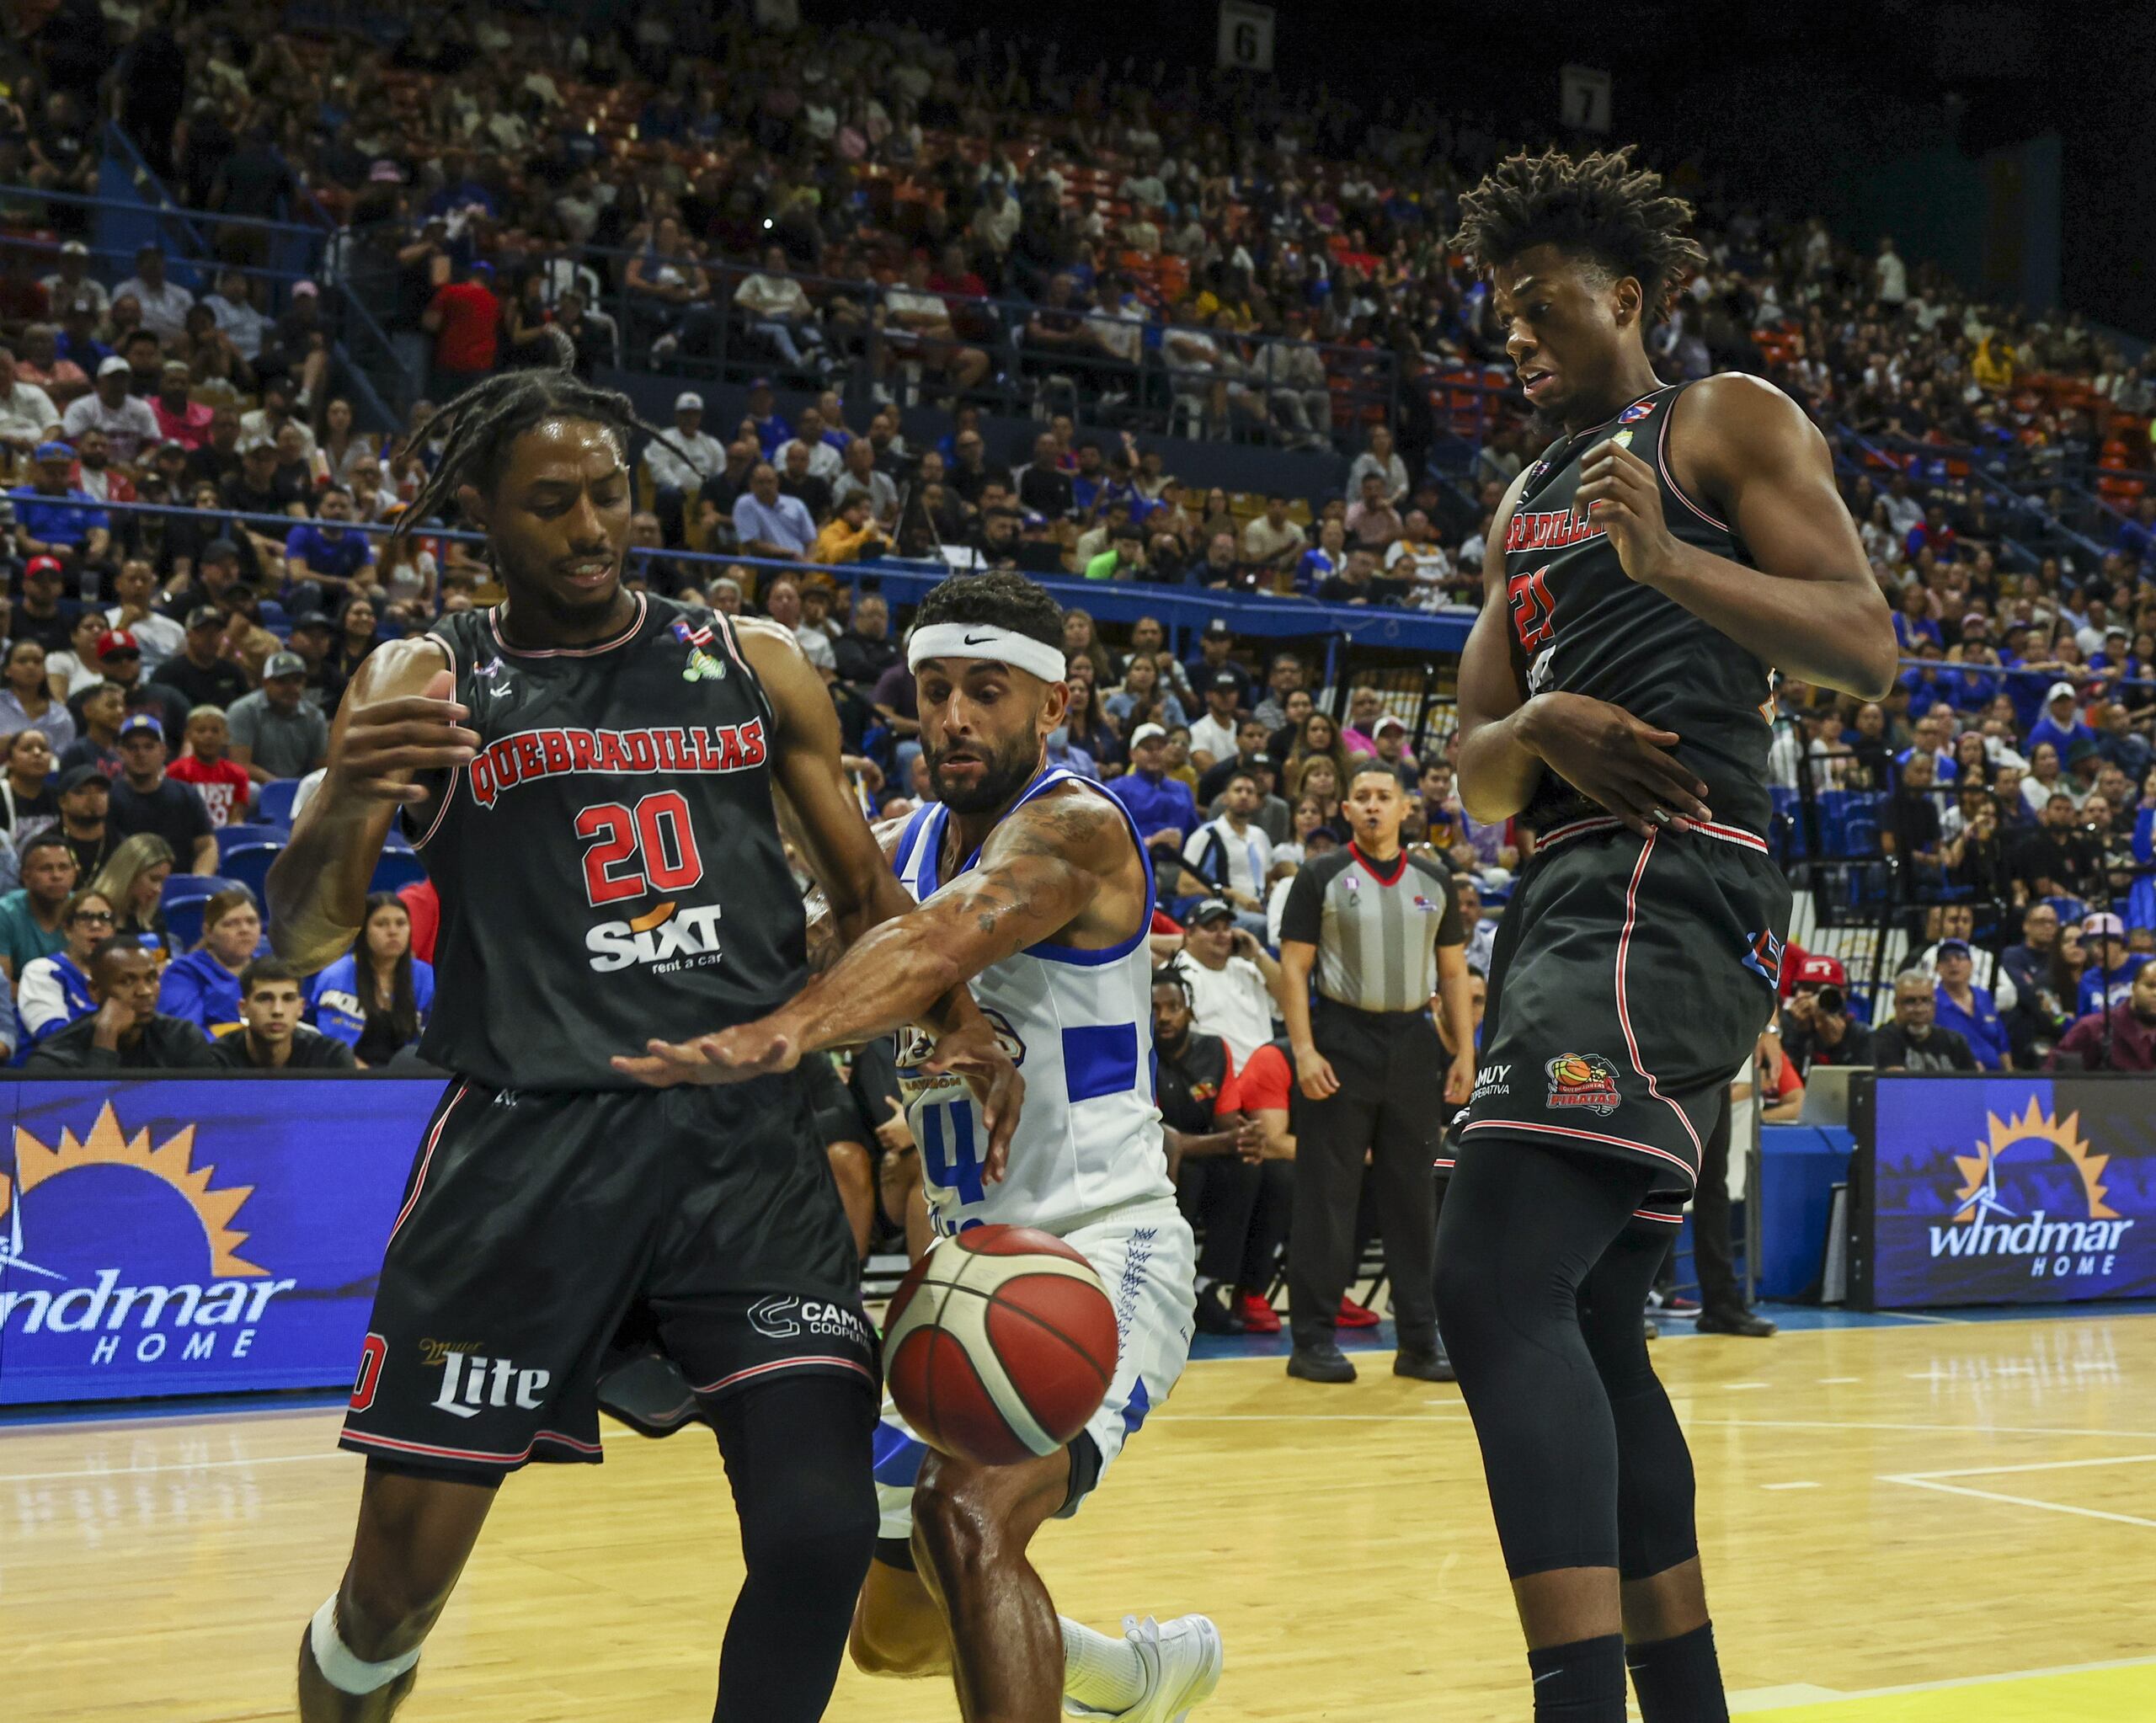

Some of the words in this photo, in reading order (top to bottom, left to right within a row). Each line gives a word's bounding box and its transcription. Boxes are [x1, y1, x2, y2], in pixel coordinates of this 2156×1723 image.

[1235, 22, 1257, 61] 6
[1577, 88, 1594, 122] 7
[1505, 499, 1607, 554] RADILL
[1508, 565, 1556, 654] 21
[469, 716, 767, 810] QUEBRADILLAS
[574, 789, 704, 908] 20
[652, 961, 680, 974] rent
[685, 959, 694, 968] a
[698, 952, 723, 967] car
[1548, 1093, 1618, 1107] PIRATAS
[922, 1100, 985, 1206] 4
[1929, 1204, 2135, 1257] windmar
[2031, 1256, 2116, 1277] HOME
[90, 1329, 256, 1366] HOME
[430, 1352, 551, 1419] Lite
